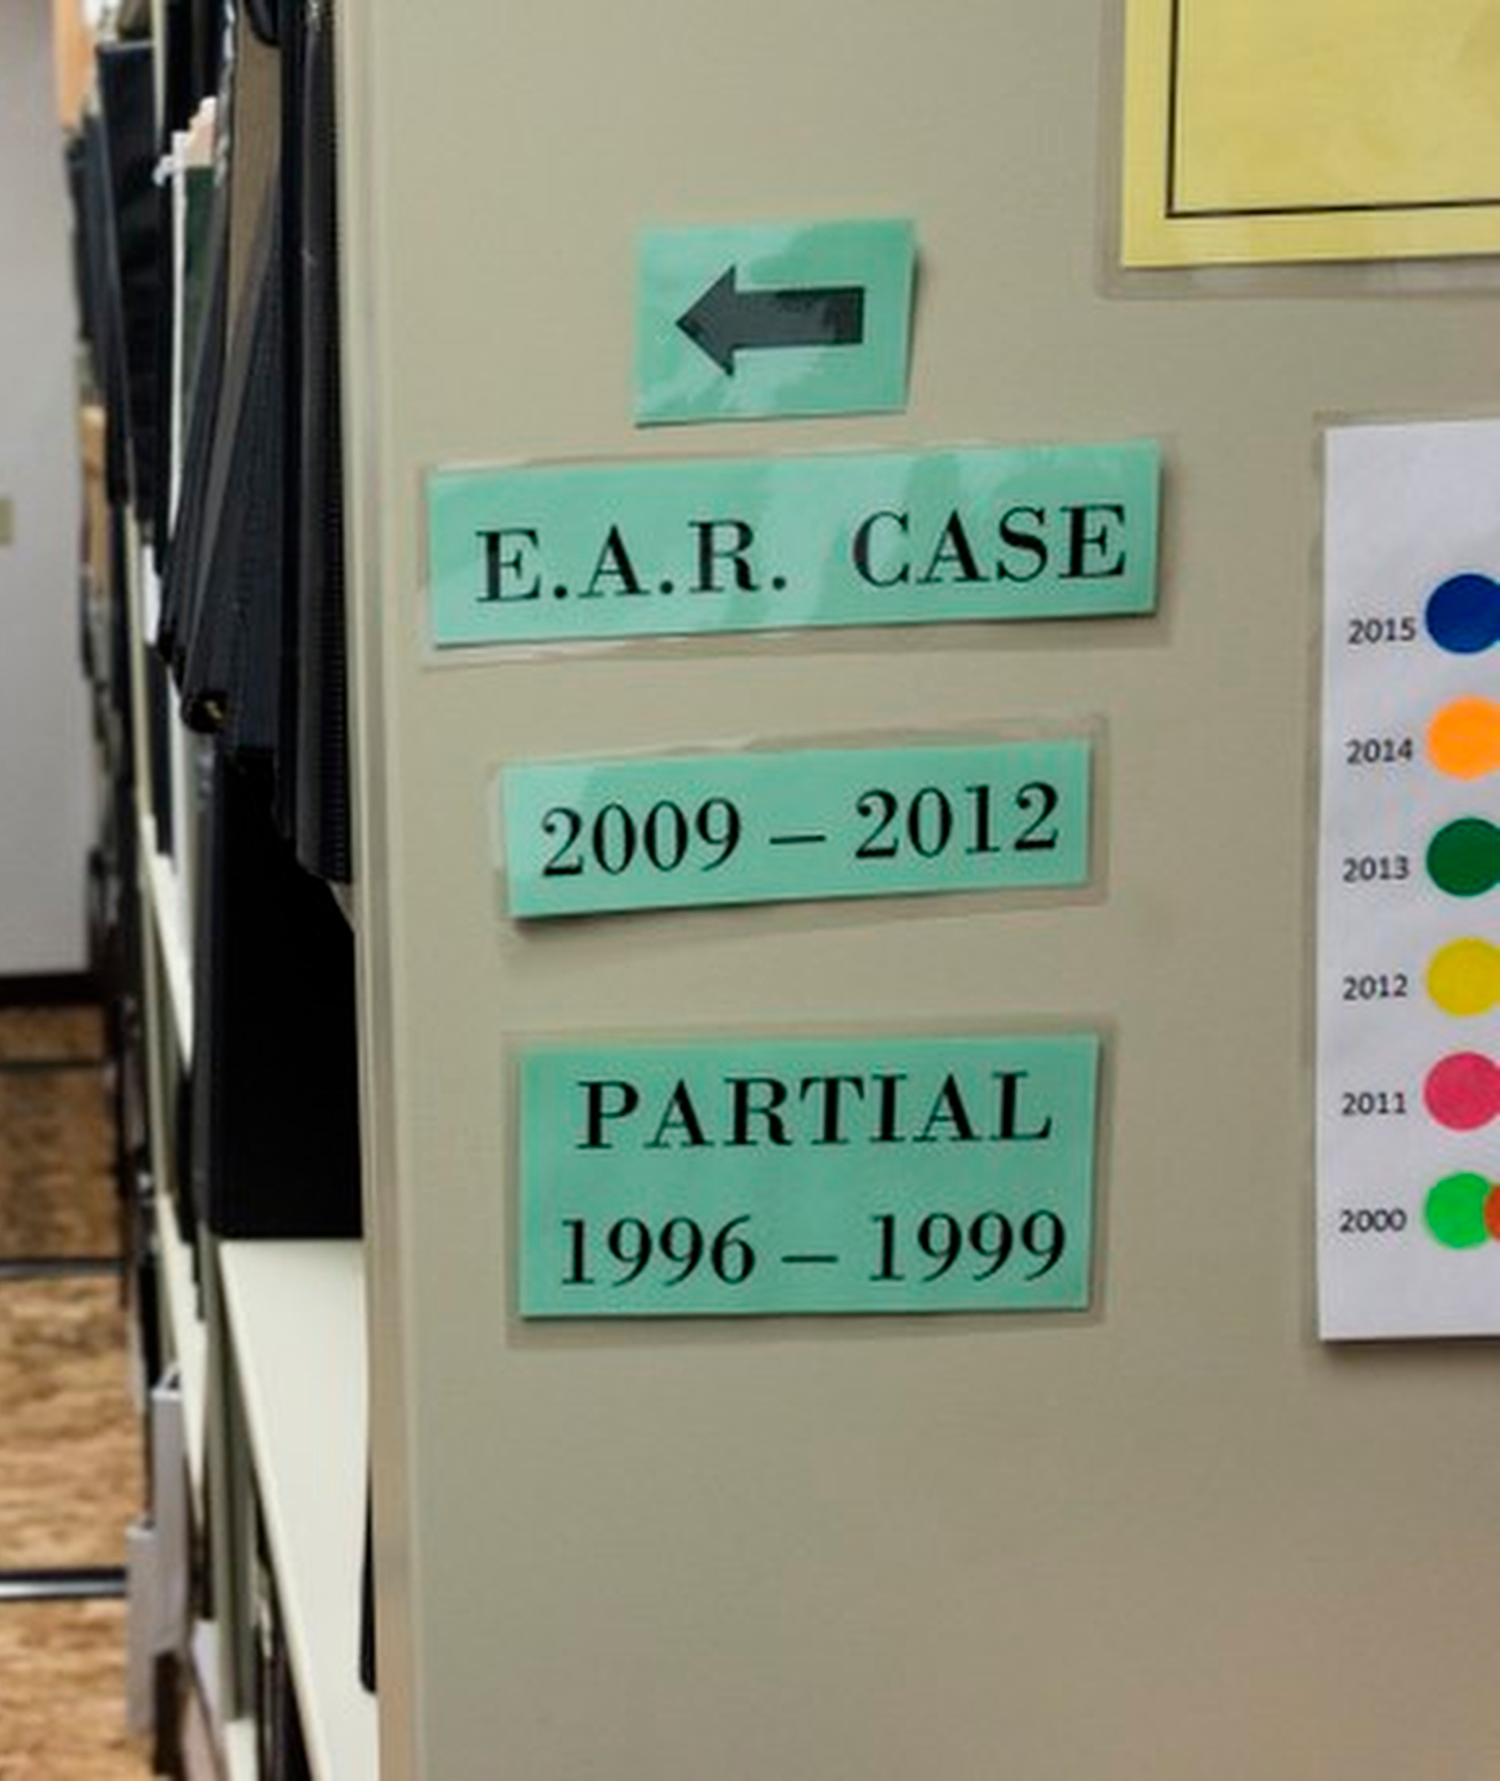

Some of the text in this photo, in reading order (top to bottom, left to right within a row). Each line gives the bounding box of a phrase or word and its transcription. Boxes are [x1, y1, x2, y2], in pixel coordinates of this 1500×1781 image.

[476, 504, 1126, 602] E.A.R. CASE
[1348, 618, 1416, 644] 2015
[1347, 738, 1413, 764] 2014
[542, 798, 742, 877] 2009
[855, 782, 1059, 860] 2012
[1343, 856, 1410, 883] 2013
[1343, 973, 1408, 1000] 2012
[577, 1072, 1052, 1150] PARTIAL
[1342, 1092, 1406, 1117] 2011
[1340, 1208, 1408, 1234] 2000
[562, 1214, 756, 1287] 1996
[870, 1210, 1066, 1282] 1999
